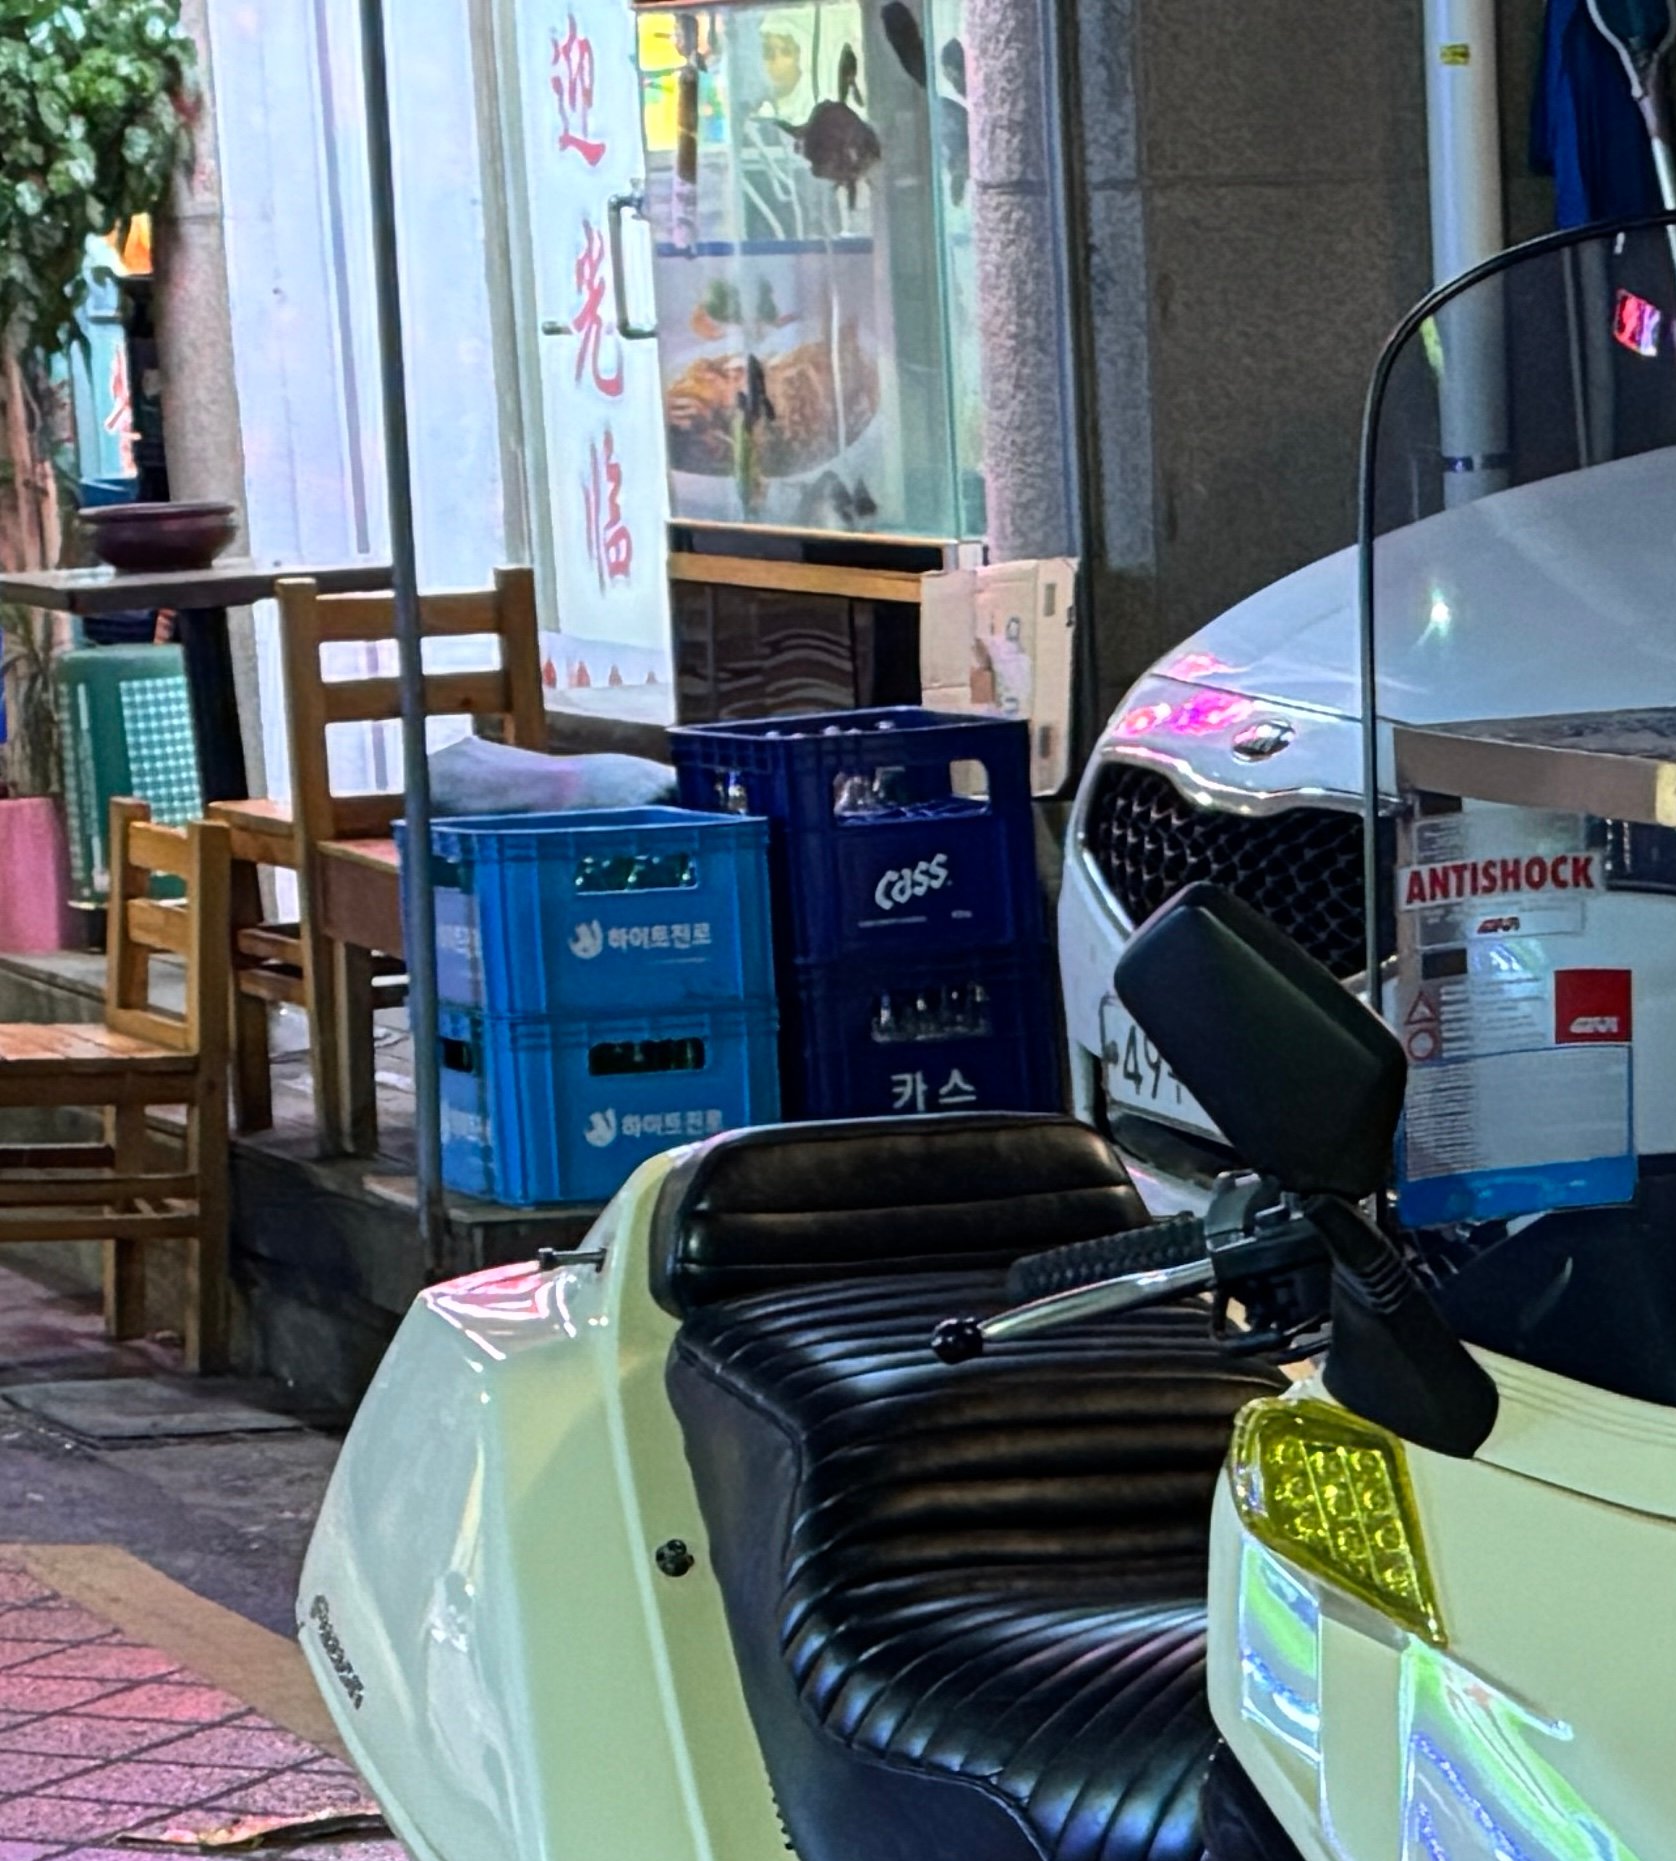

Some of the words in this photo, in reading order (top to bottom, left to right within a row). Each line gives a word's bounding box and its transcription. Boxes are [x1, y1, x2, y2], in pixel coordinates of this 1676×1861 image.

[1406, 855, 1595, 904] ANTISHOCK
[608, 922, 712, 953] 하이트진로
[890, 1068, 978, 1112] 카스
